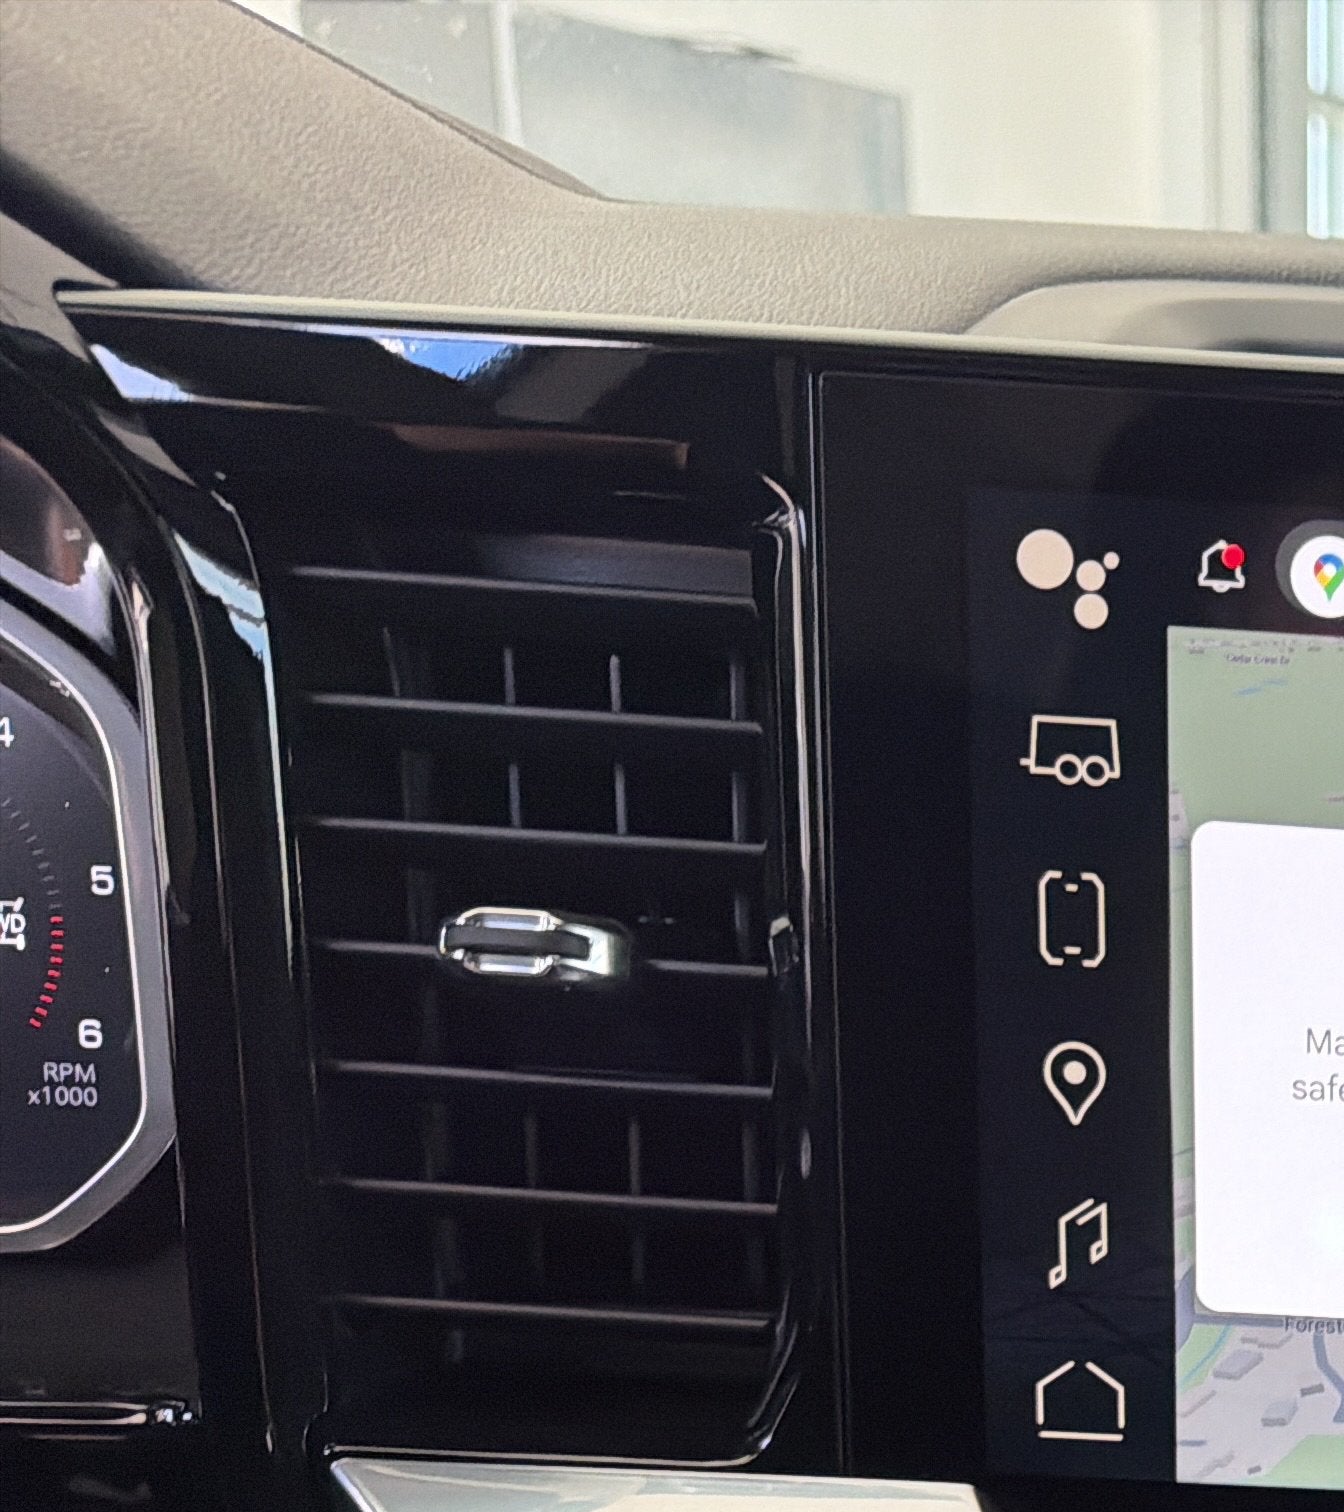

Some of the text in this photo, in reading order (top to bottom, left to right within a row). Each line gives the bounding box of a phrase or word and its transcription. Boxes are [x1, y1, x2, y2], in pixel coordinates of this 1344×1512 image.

[90, 865, 115, 895] 5
[78, 1018, 103, 1048] 6
[43, 1061, 97, 1084] RPM
[27, 1085, 98, 1107] x1000
[1285, 1316, 1343, 1335] Forest
